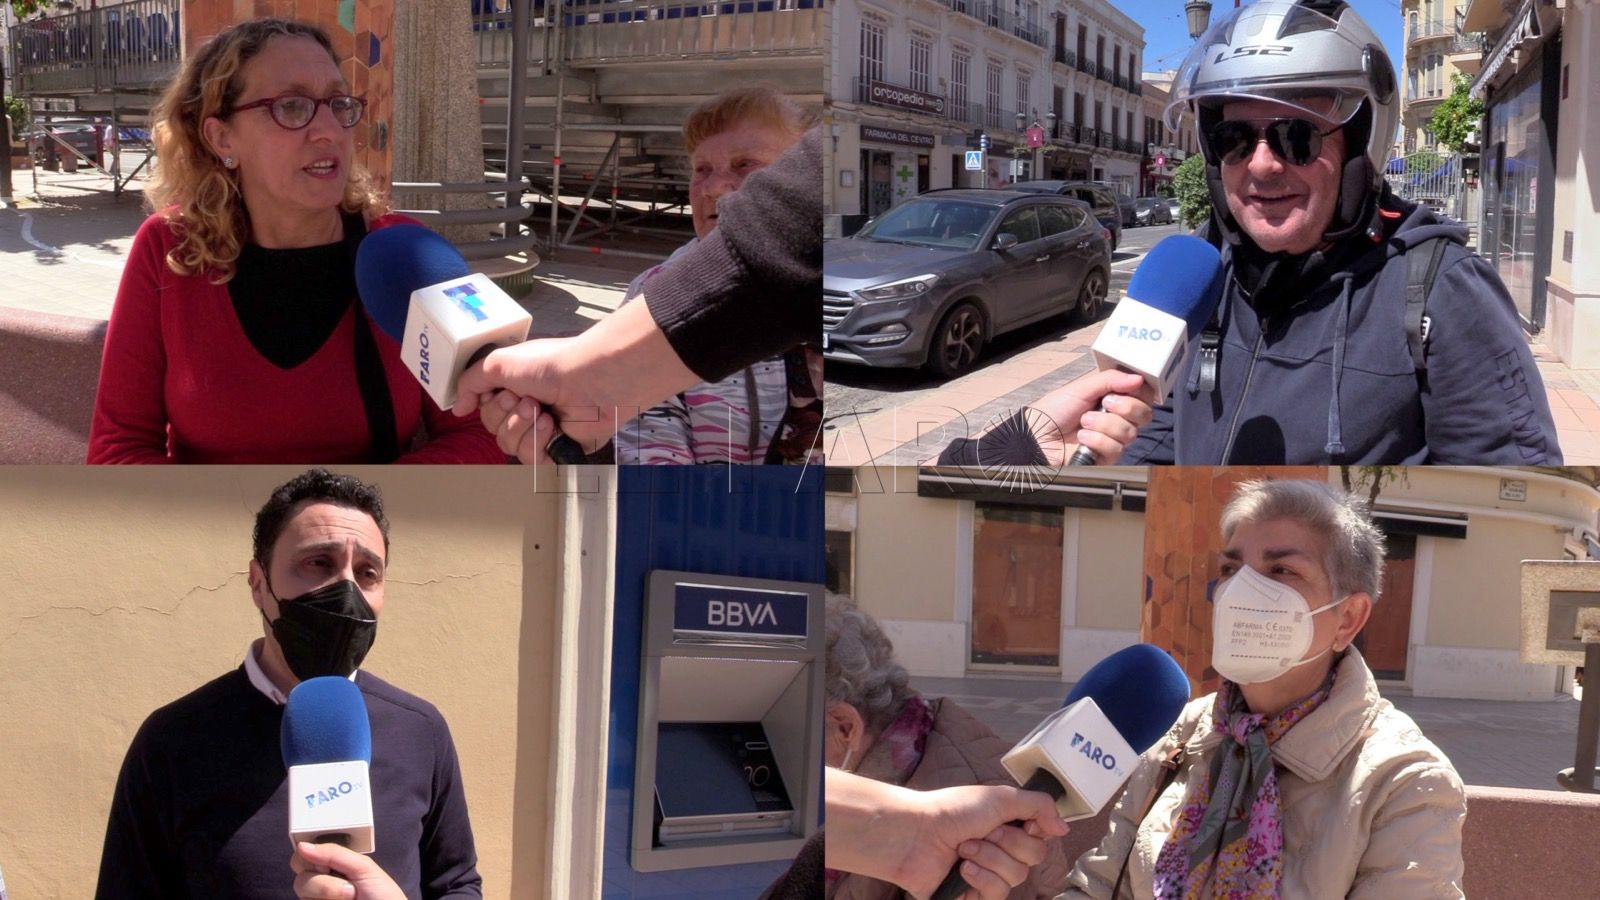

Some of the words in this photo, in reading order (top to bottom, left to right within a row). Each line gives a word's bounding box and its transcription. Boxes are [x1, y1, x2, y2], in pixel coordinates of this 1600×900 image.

[873, 87, 925, 105] ortopedia
[864, 128, 897, 140] FARMACIA
[898, 133, 910, 142] DEL
[910, 135, 934, 145] CENTRO
[707, 600, 778, 627] BBVA
